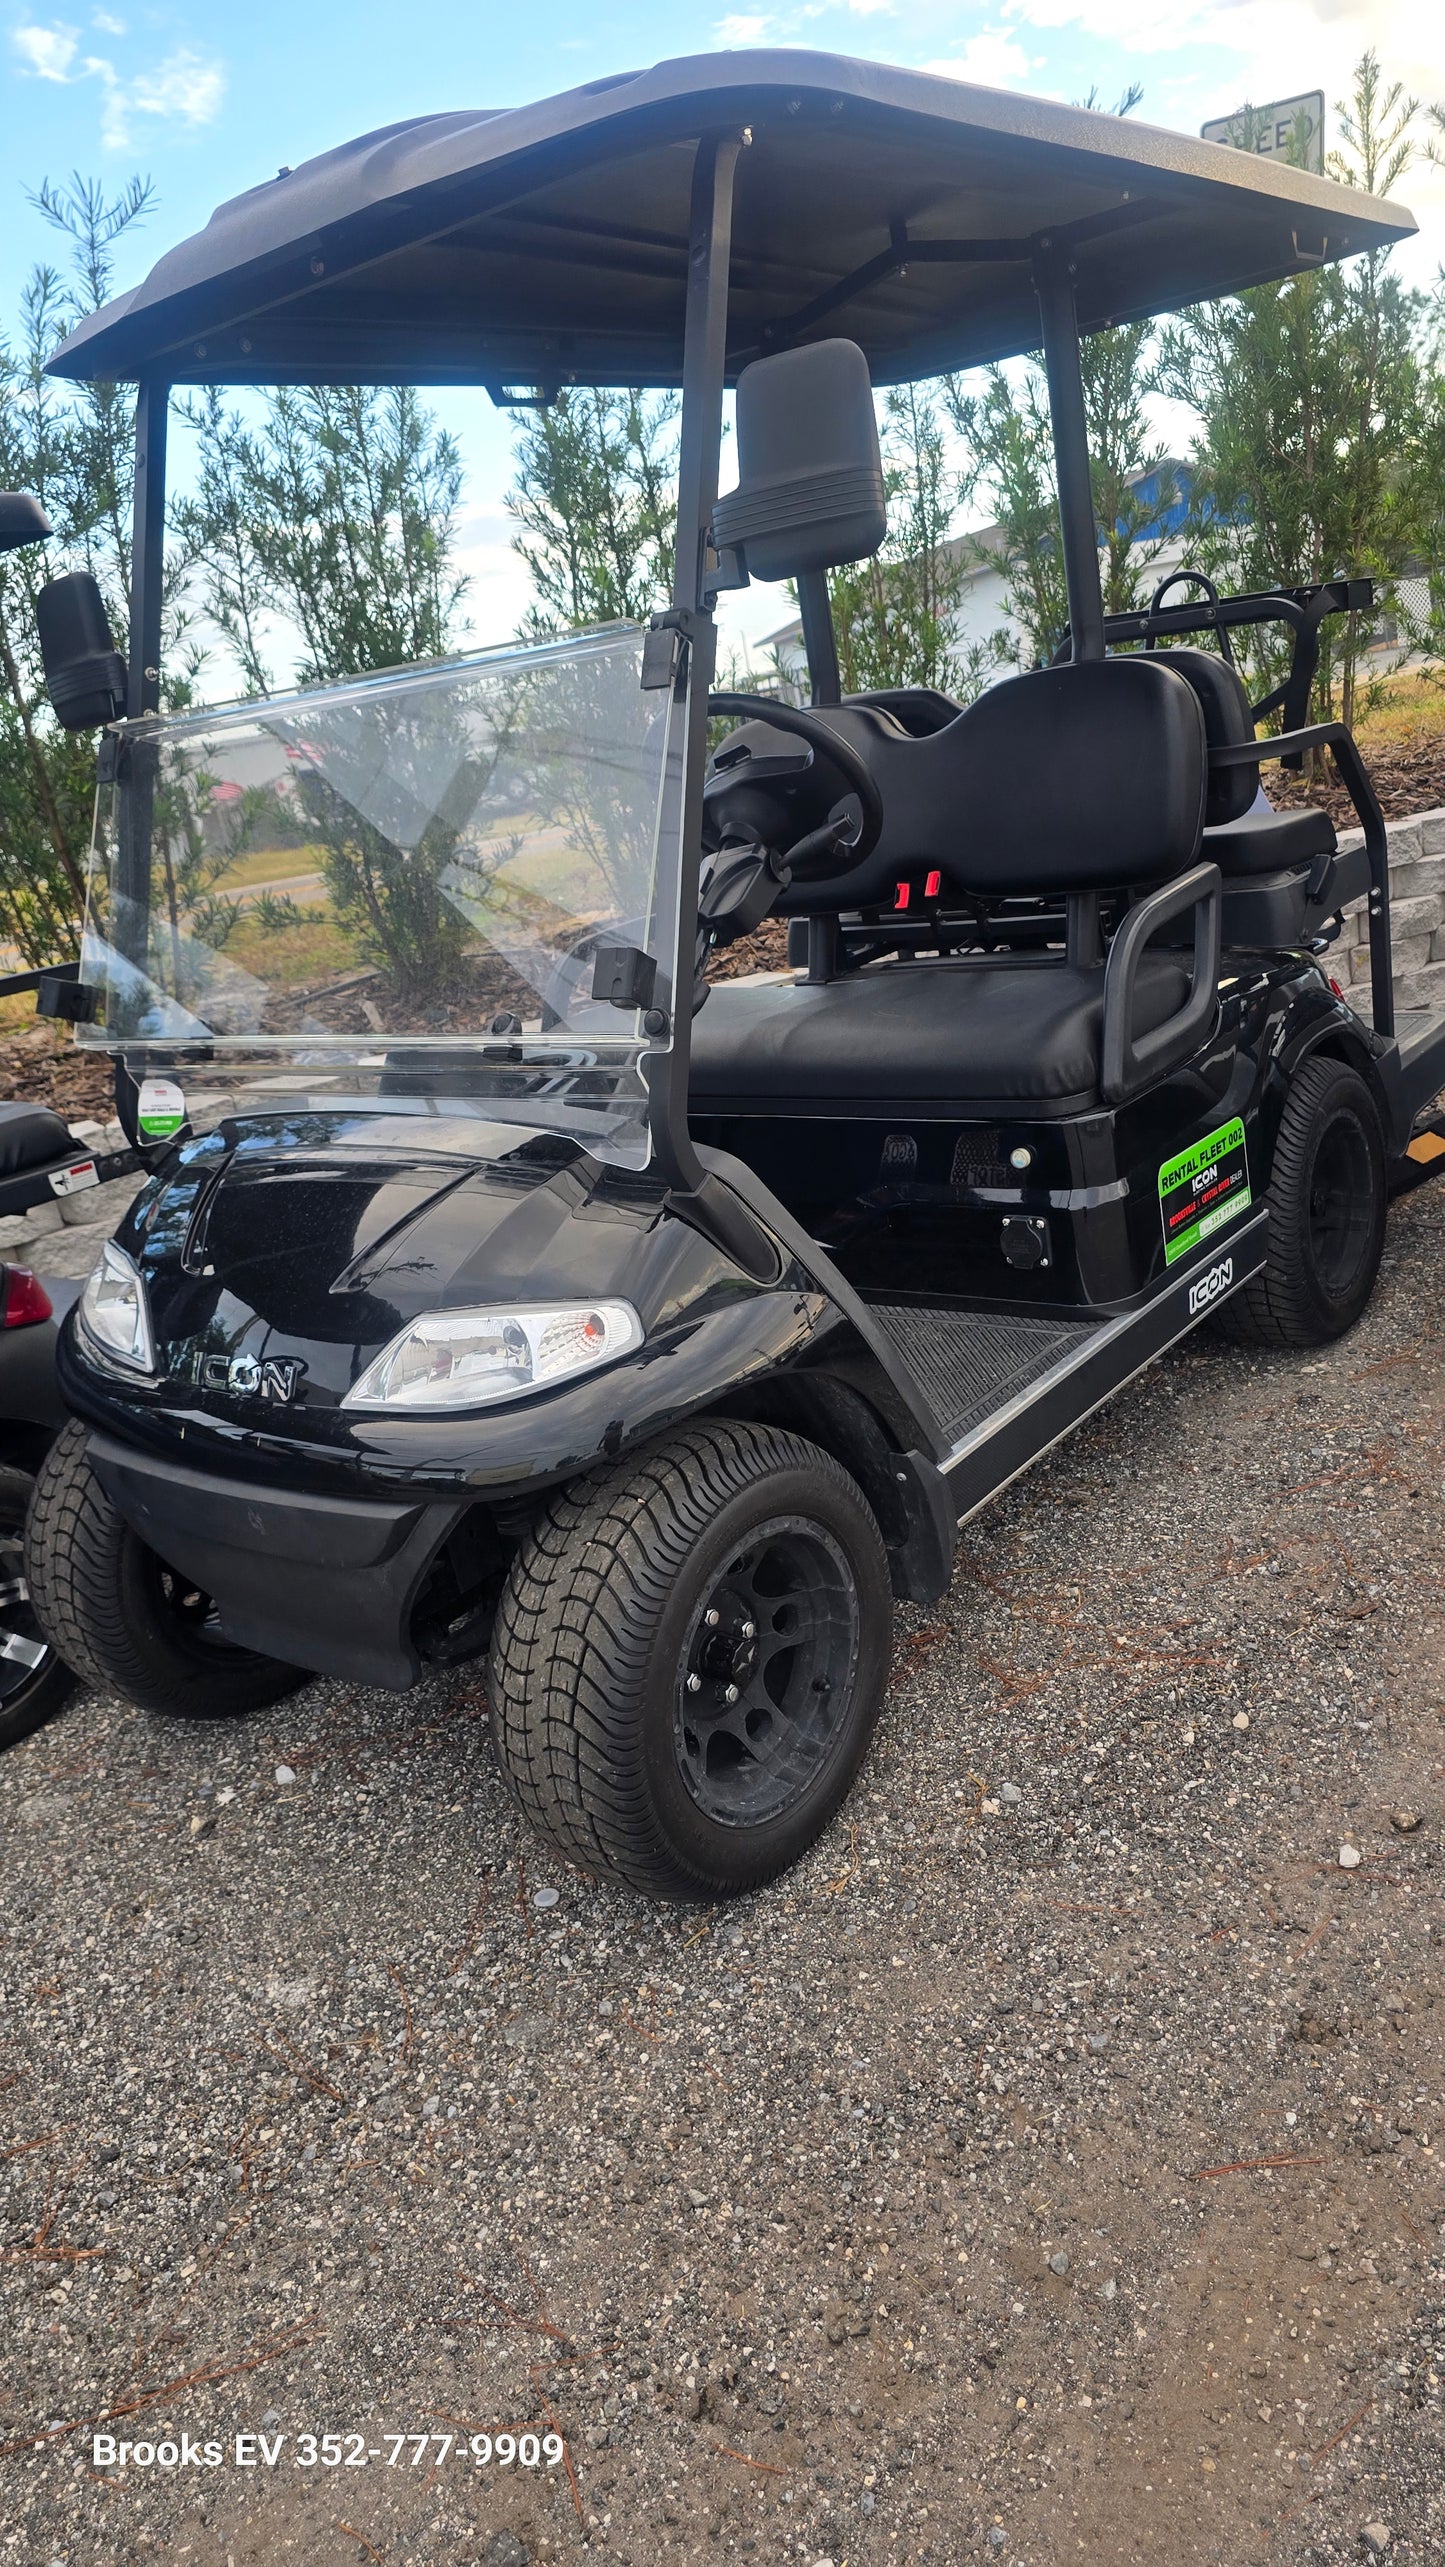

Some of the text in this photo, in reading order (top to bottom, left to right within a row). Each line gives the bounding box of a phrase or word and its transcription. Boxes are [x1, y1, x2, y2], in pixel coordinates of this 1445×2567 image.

[1161, 1157, 1199, 1192] RENTAL
[1199, 1137, 1227, 1166] FLEET
[1228, 1127, 1244, 1146] 002
[1191, 1164, 1218, 1192] ICON
[1189, 1258, 1233, 1314] ICON
[191, 1351, 299, 1401] ICON
